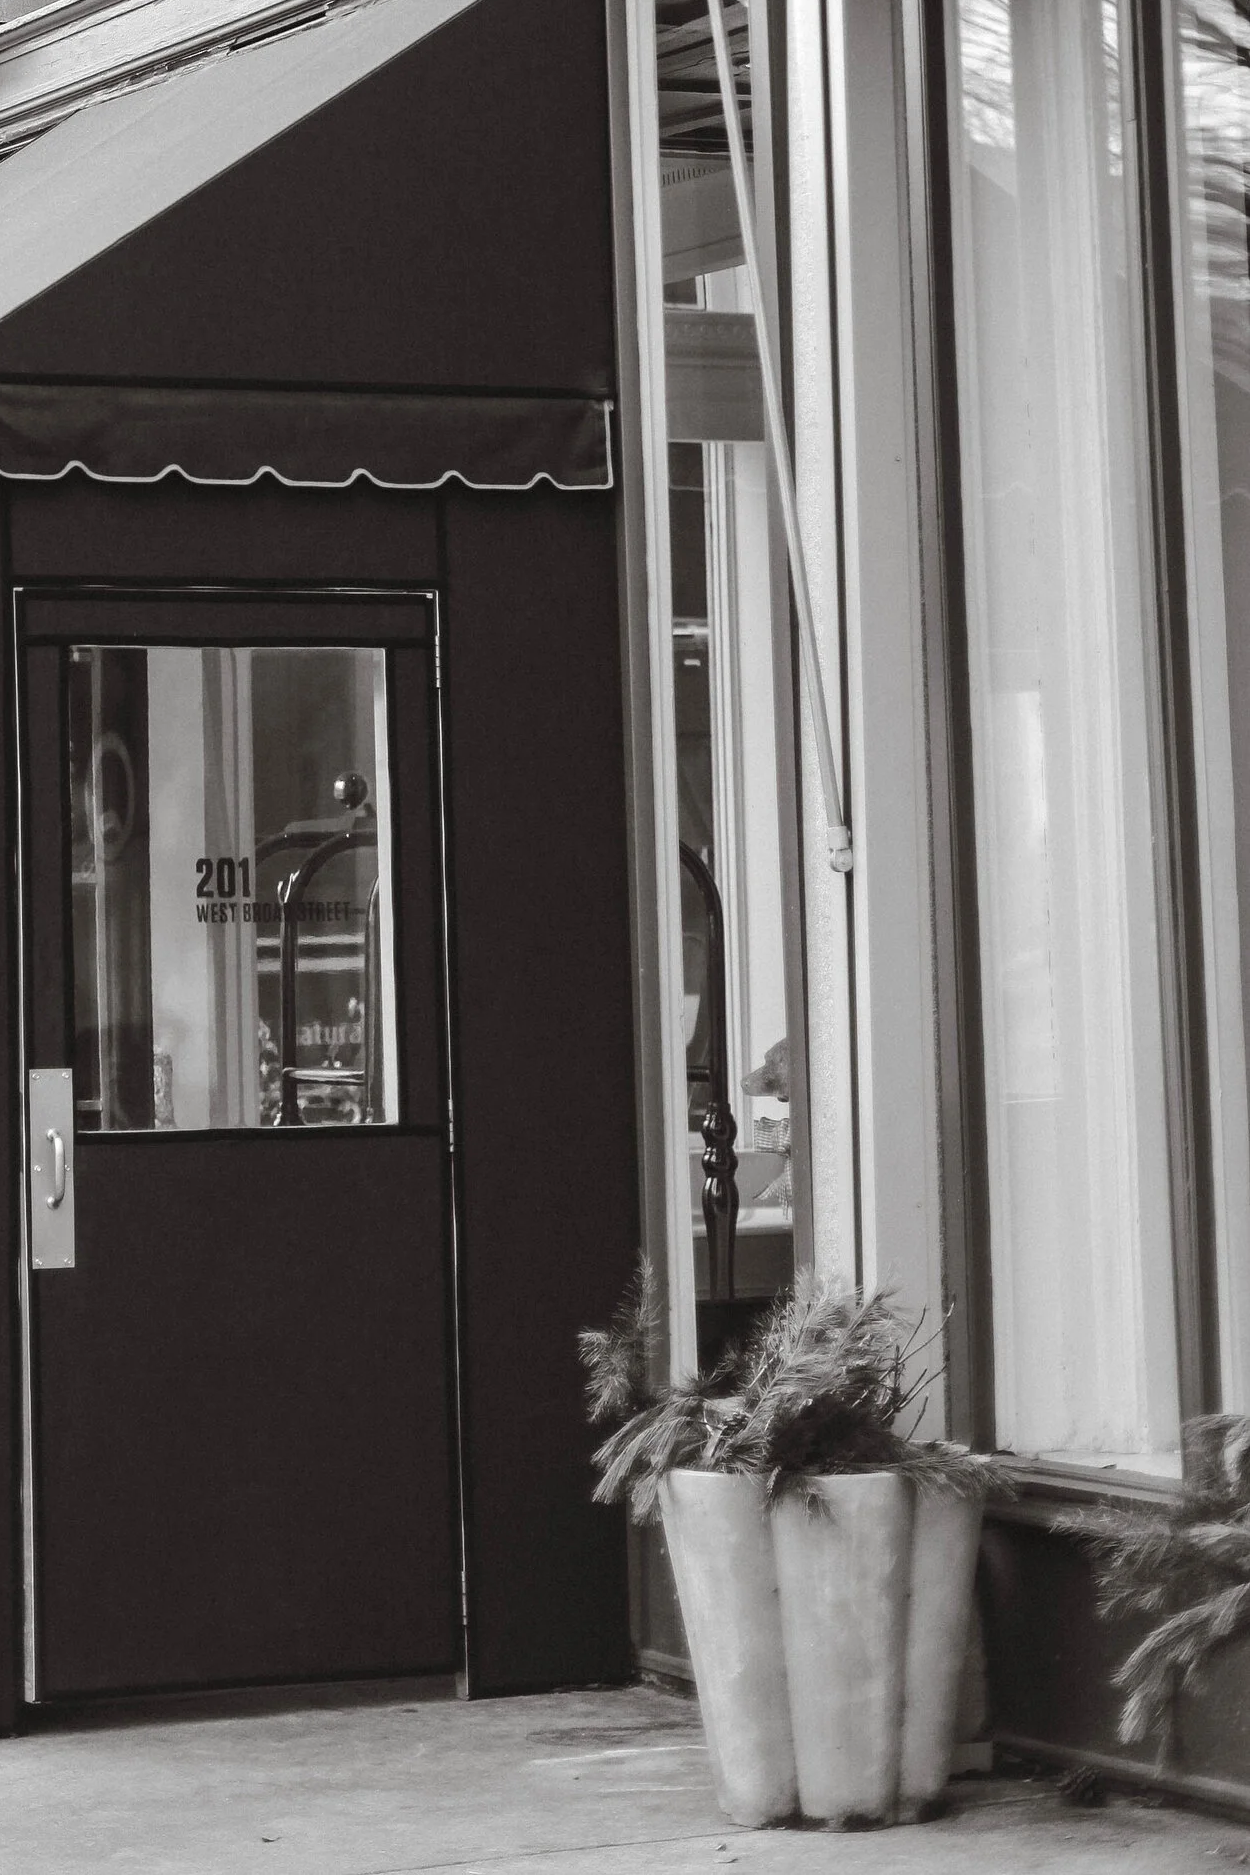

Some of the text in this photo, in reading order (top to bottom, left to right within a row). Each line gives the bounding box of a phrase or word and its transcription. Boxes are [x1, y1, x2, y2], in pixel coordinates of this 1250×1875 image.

[195, 857, 250, 898] 201
[196, 901, 350, 923] WEST BROA STREET
